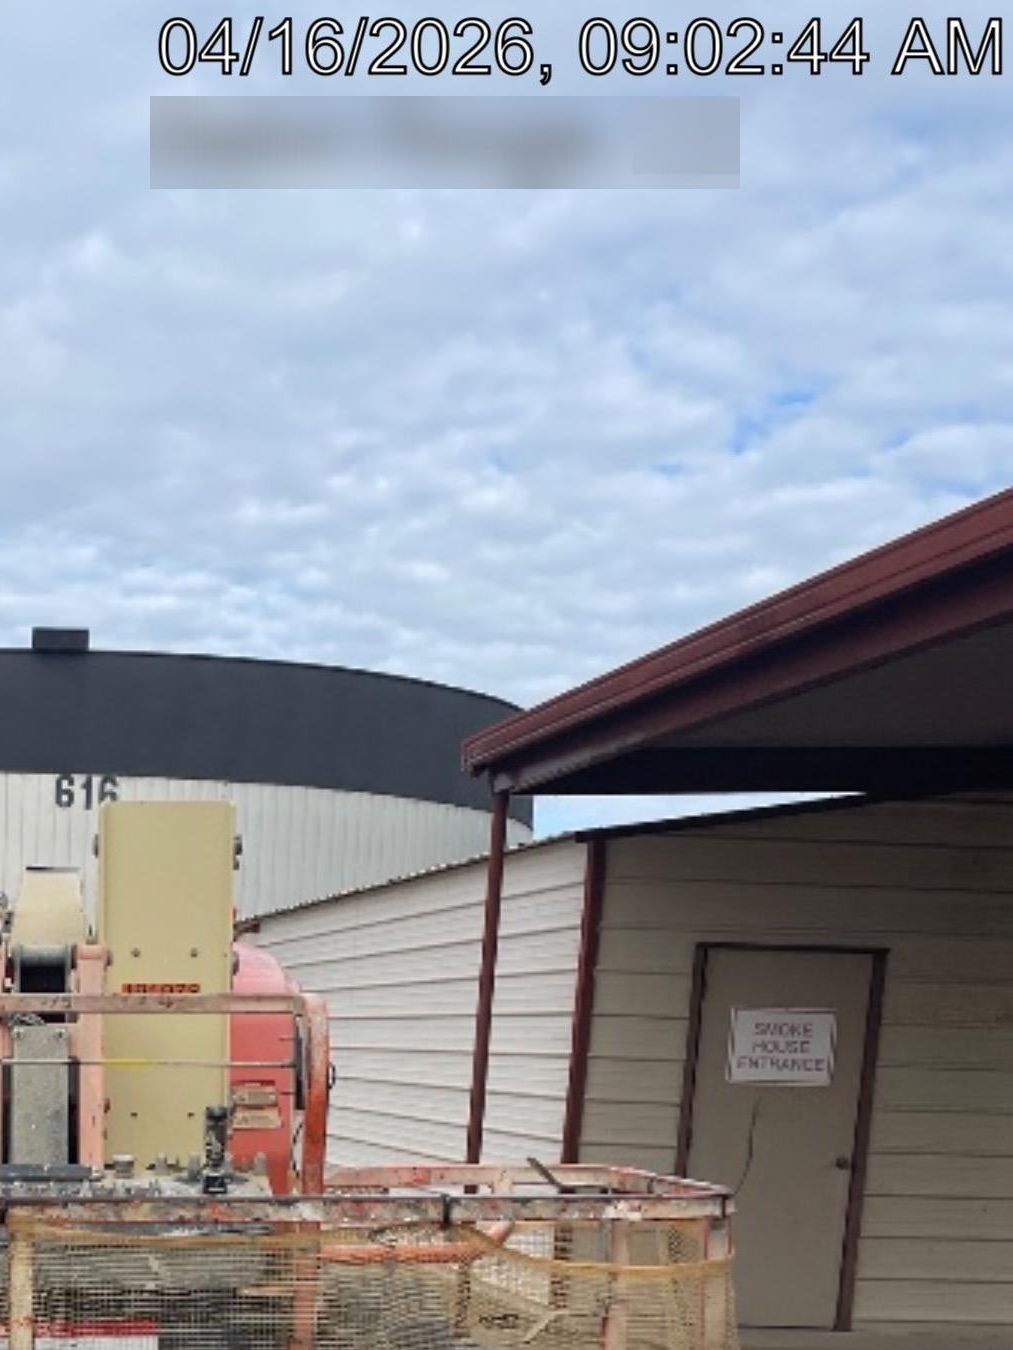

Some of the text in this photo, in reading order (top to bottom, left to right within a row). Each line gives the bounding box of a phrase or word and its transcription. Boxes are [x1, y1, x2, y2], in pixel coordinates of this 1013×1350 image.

[55, 774, 118, 810] 616
[754, 1022, 813, 1038] SMOKE
[752, 1040, 811, 1054] HOUSE
[737, 1056, 826, 1072] ENTRANCE
